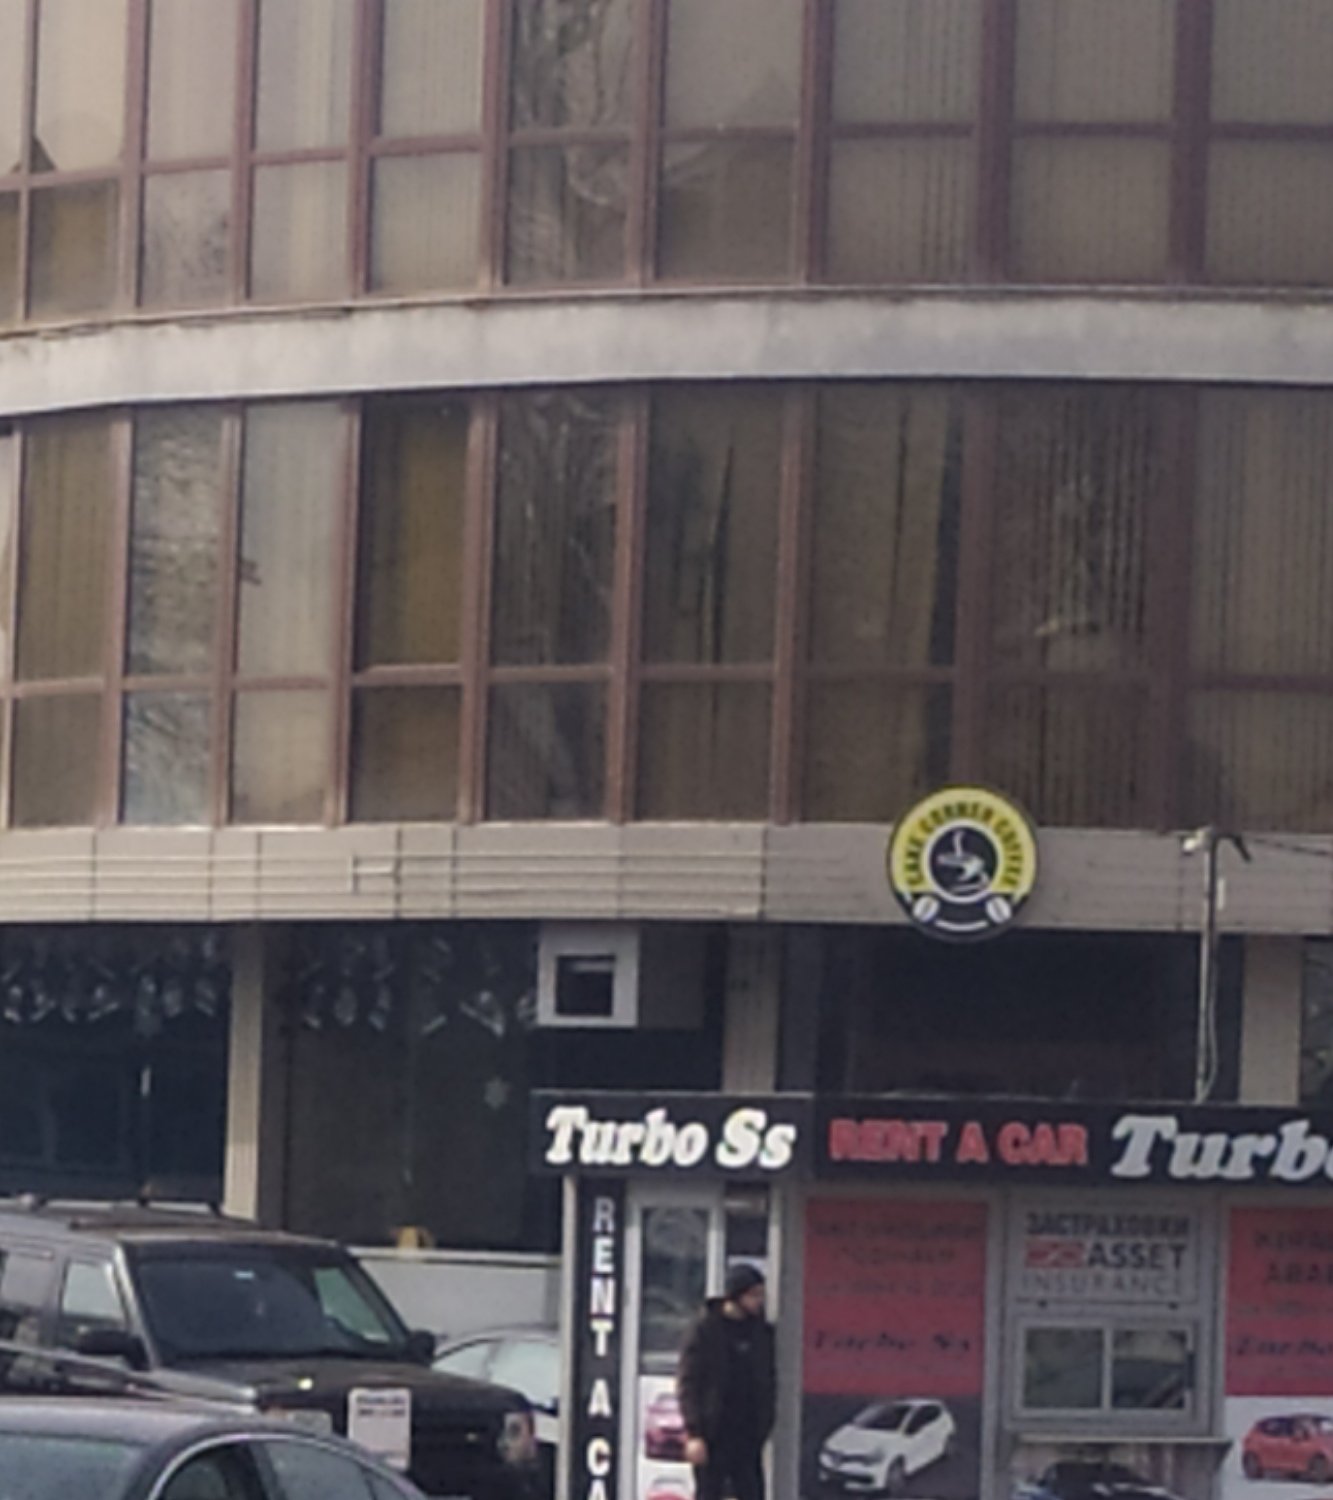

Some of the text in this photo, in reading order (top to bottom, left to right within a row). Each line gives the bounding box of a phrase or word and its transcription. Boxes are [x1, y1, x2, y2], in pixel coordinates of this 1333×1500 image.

[544, 1106, 797, 1168] Turbo Ss
[828, 1118, 1089, 1165] RENT A CAR
[1109, 1114, 1333, 1182] Turb
[590, 1196, 616, 1357] RENT
[1088, 1241, 1186, 1270] ASSET
[588, 1378, 612, 1418] A
